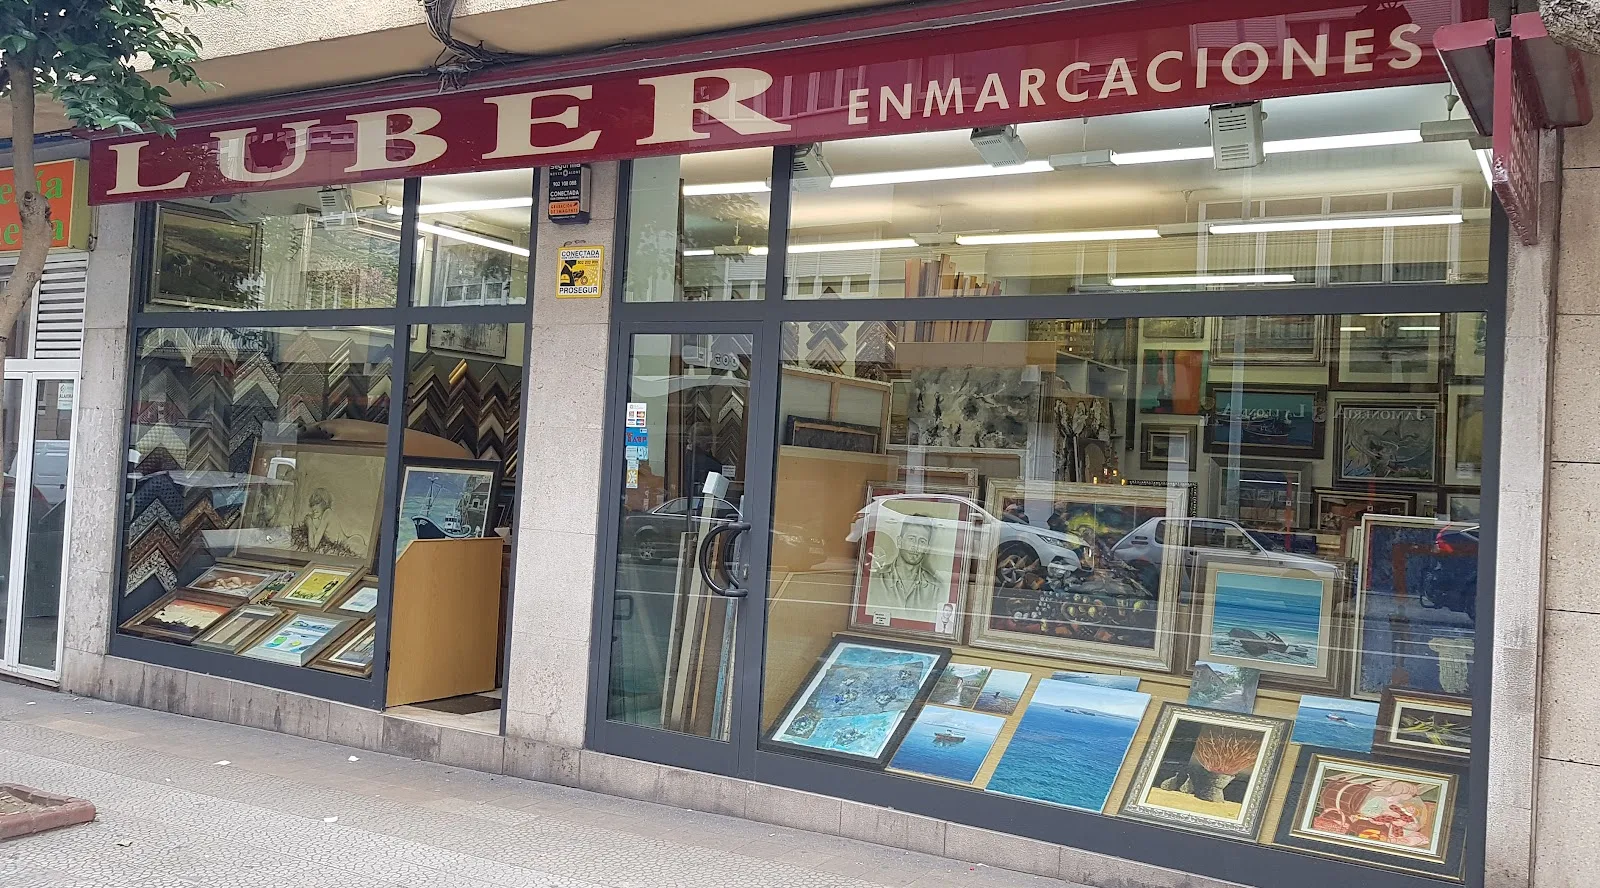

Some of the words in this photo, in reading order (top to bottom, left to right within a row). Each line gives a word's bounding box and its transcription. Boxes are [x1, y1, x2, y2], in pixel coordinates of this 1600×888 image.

[847, 23, 1423, 126] ENMARCACIONES
[106, 67, 792, 196] LUBER
[561, 249, 600, 257] CONECTADA
[559, 286, 598, 294] PROSEGUR
